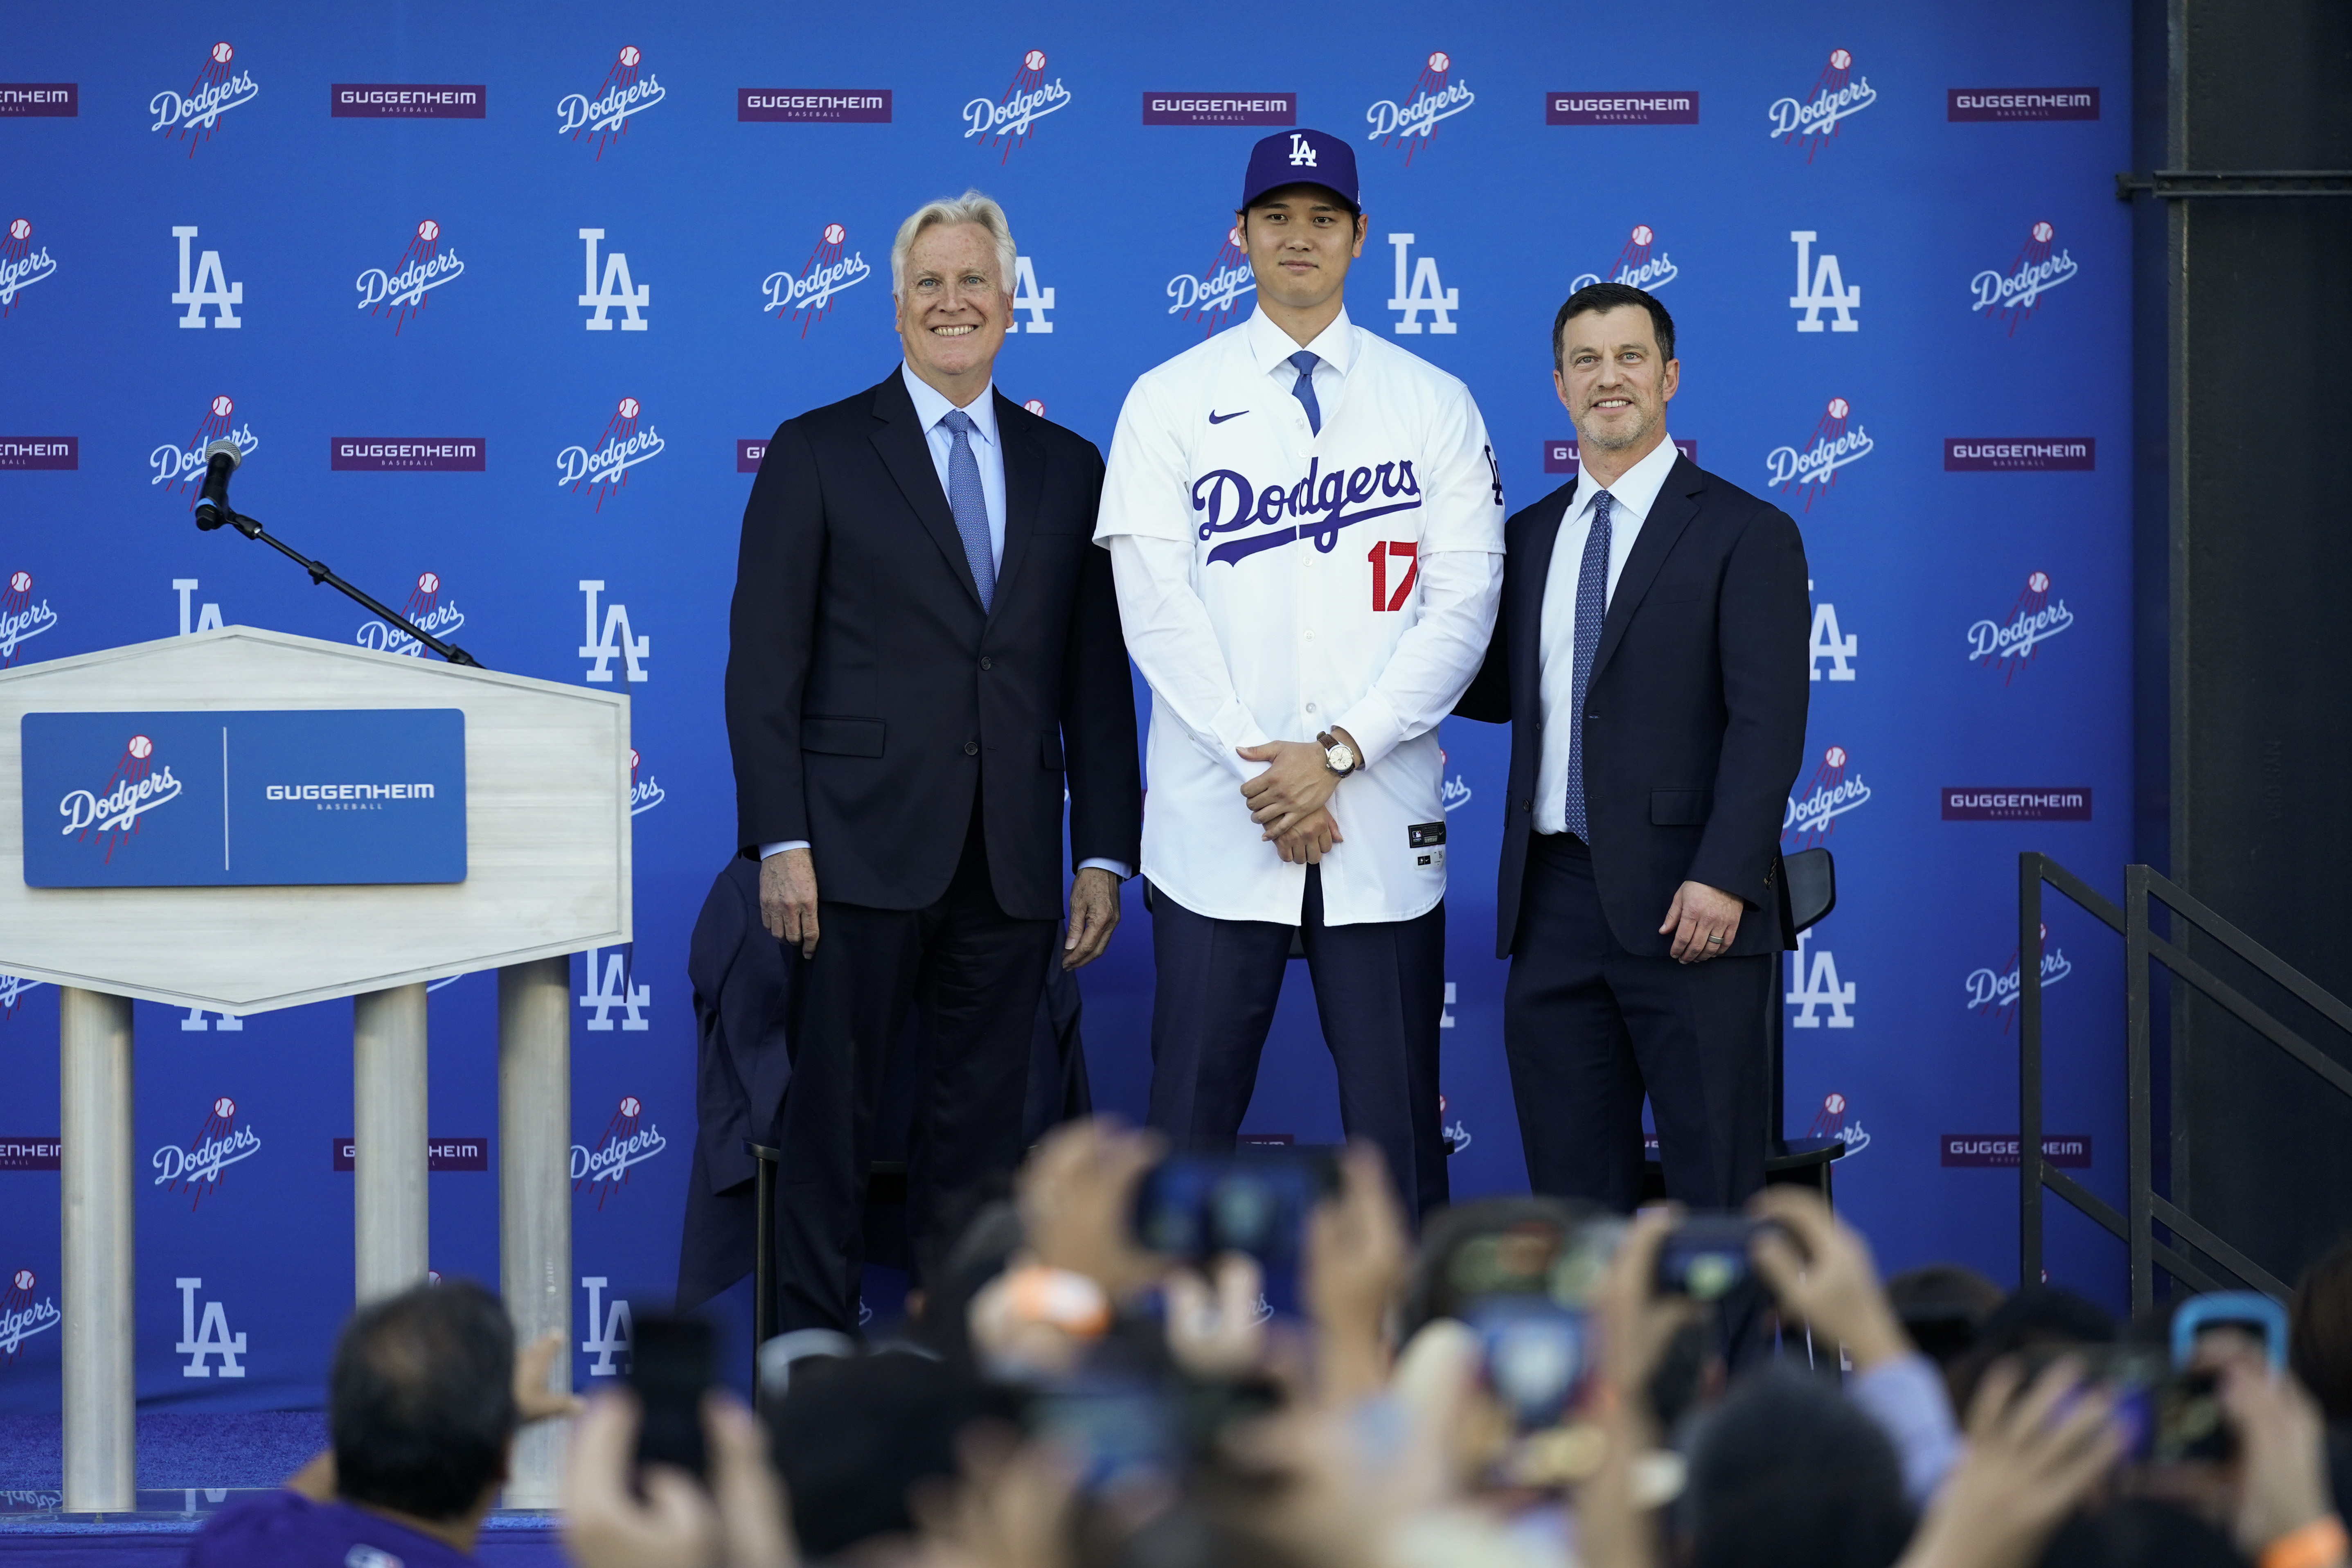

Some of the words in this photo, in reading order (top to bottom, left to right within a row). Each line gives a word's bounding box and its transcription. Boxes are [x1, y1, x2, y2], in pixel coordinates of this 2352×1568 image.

[0, 91, 68, 102] NHEIM
[150, 70, 258, 131] Dodgers
[342, 92, 475, 104] GUGGENHEIM
[557, 74, 665, 133] Dodgers
[748, 96, 882, 108] GUGGENHEIM
[963, 78, 1070, 137] Dodgers
[1153, 100, 1286, 111] GUGGENHEIM
[1367, 80, 1474, 140] Dodgers
[1556, 99, 1689, 110] GUGGENHEIM
[1769, 77, 1876, 137] Dodgers
[1957, 95, 2090, 108] GUGGENHEIM
[1289, 134, 1317, 167] LA
[0, 247, 56, 304] dgers
[172, 226, 242, 328] LA
[356, 248, 464, 309] Dodgers
[579, 229, 649, 330] LA
[763, 252, 870, 311] Dodgers
[1005, 257, 1054, 333] A
[1167, 260, 1256, 314] Dodge
[1388, 234, 1458, 333] LA
[1570, 252, 1678, 293] dgers
[1790, 231, 1860, 332] LA
[1971, 250, 2077, 311] Dodgers
[0, 444, 68, 455] NHEIM
[150, 424, 258, 484] Dodrs
[341, 445, 475, 457] GUGGENHEIM
[557, 426, 664, 486] Dodgers
[1767, 426, 1873, 487] Dodgers
[1954, 445, 2085, 457] GUGGENHEIM
[1192, 457, 1422, 567] Dodgers
[1368, 541, 1418, 612] 17
[0, 599, 57, 657] dgers
[579, 580, 649, 681] LA
[1808, 579, 1857, 681] A
[1968, 600, 2073, 660] Dodgers
[60, 766, 181, 835] Dodgers
[267, 784, 434, 800] GUGGENHEIM
[1951, 795, 2082, 807] GUGGENHEIM
[580, 948, 650, 1030] LA
[1786, 927, 1856, 1028] LA
[1966, 948, 2072, 1009] Dodrs
[0, 1144, 61, 1156] ENHEI
[153, 1125, 260, 1184] Dodgers
[570, 1124, 666, 1181] Dodgers
[1950, 1141, 2082, 1155] GUGGEEIM
[0, 1297, 60, 1353] dgers
[176, 1278, 246, 1377] LA
